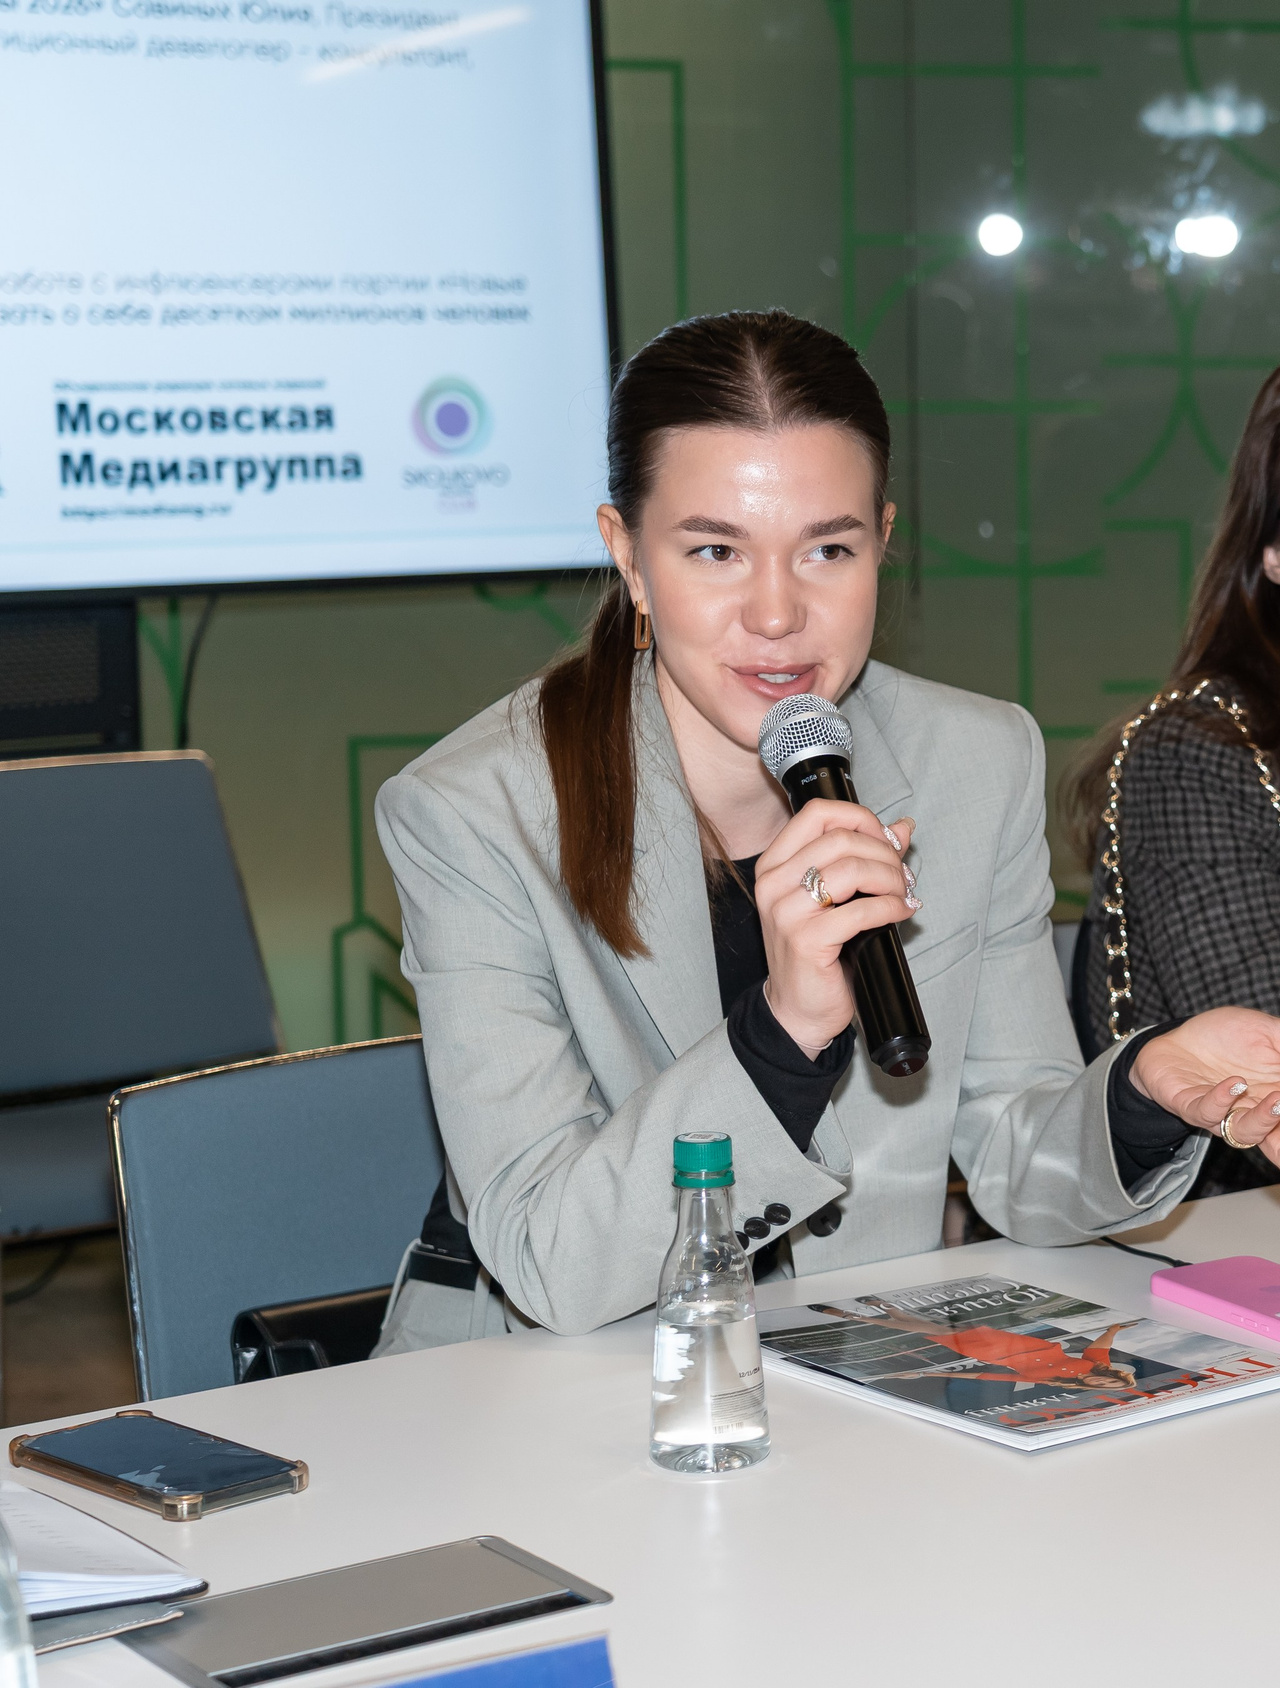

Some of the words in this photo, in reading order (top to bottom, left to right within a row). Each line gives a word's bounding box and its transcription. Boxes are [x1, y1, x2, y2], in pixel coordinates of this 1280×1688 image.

[142, 35, 293, 62] девелопер
[0, 269, 82, 296] аботе
[87, 299, 153, 327] себе
[288, 302, 426, 327] миллионов
[55, 399, 337, 435] Московская
[60, 451, 365, 494] Медиагруппа
[925, 1287, 1051, 1319] Юлия
[963, 1392, 1080, 1419] ГЛЯНЕЦ
